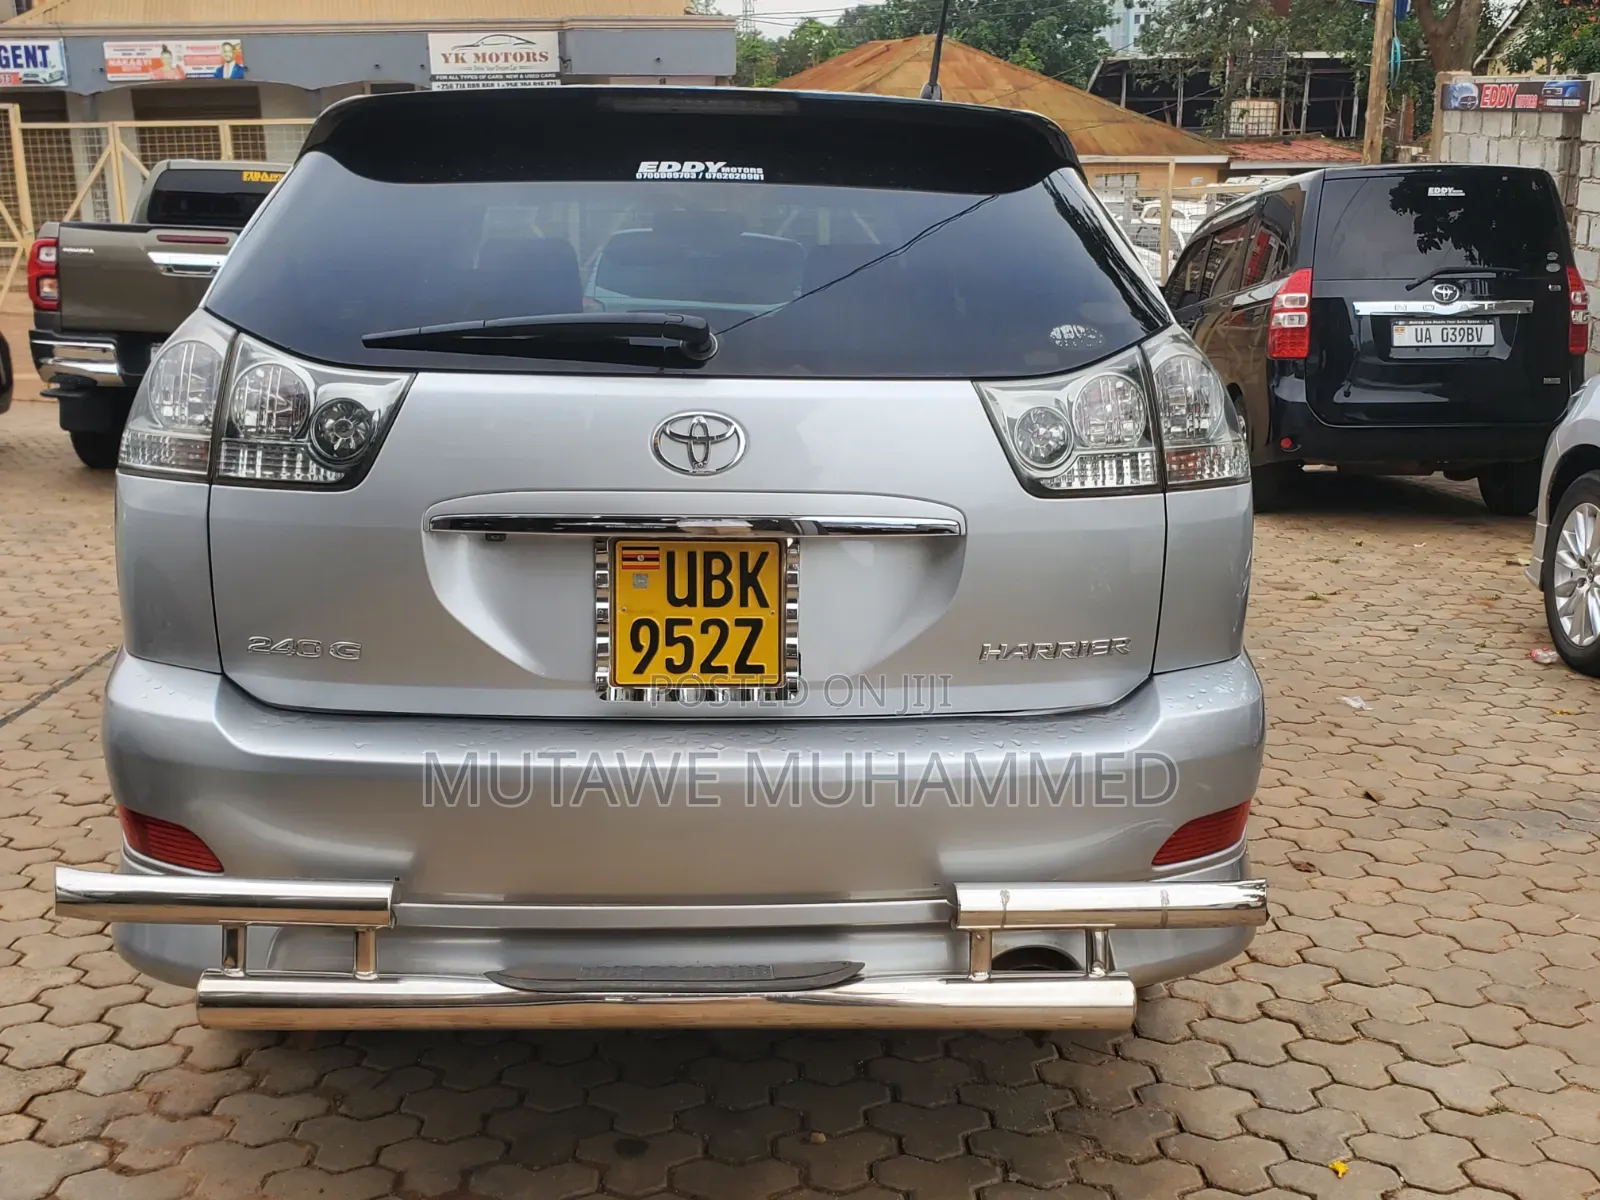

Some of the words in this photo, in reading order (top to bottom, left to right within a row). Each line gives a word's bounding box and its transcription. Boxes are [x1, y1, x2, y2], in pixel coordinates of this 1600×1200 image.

[441, 52, 467, 64] YK
[473, 51, 549, 64] MOTORS
[1480, 84, 1519, 109] EDDY
[637, 161, 727, 173] EDDY
[721, 166, 763, 174] MOTORS
[1414, 327, 1433, 343] UA
[666, 551, 770, 608] UBK
[247, 636, 322, 657] 240
[630, 617, 766, 675] 952Z
[979, 637, 1132, 661] HARRIER
